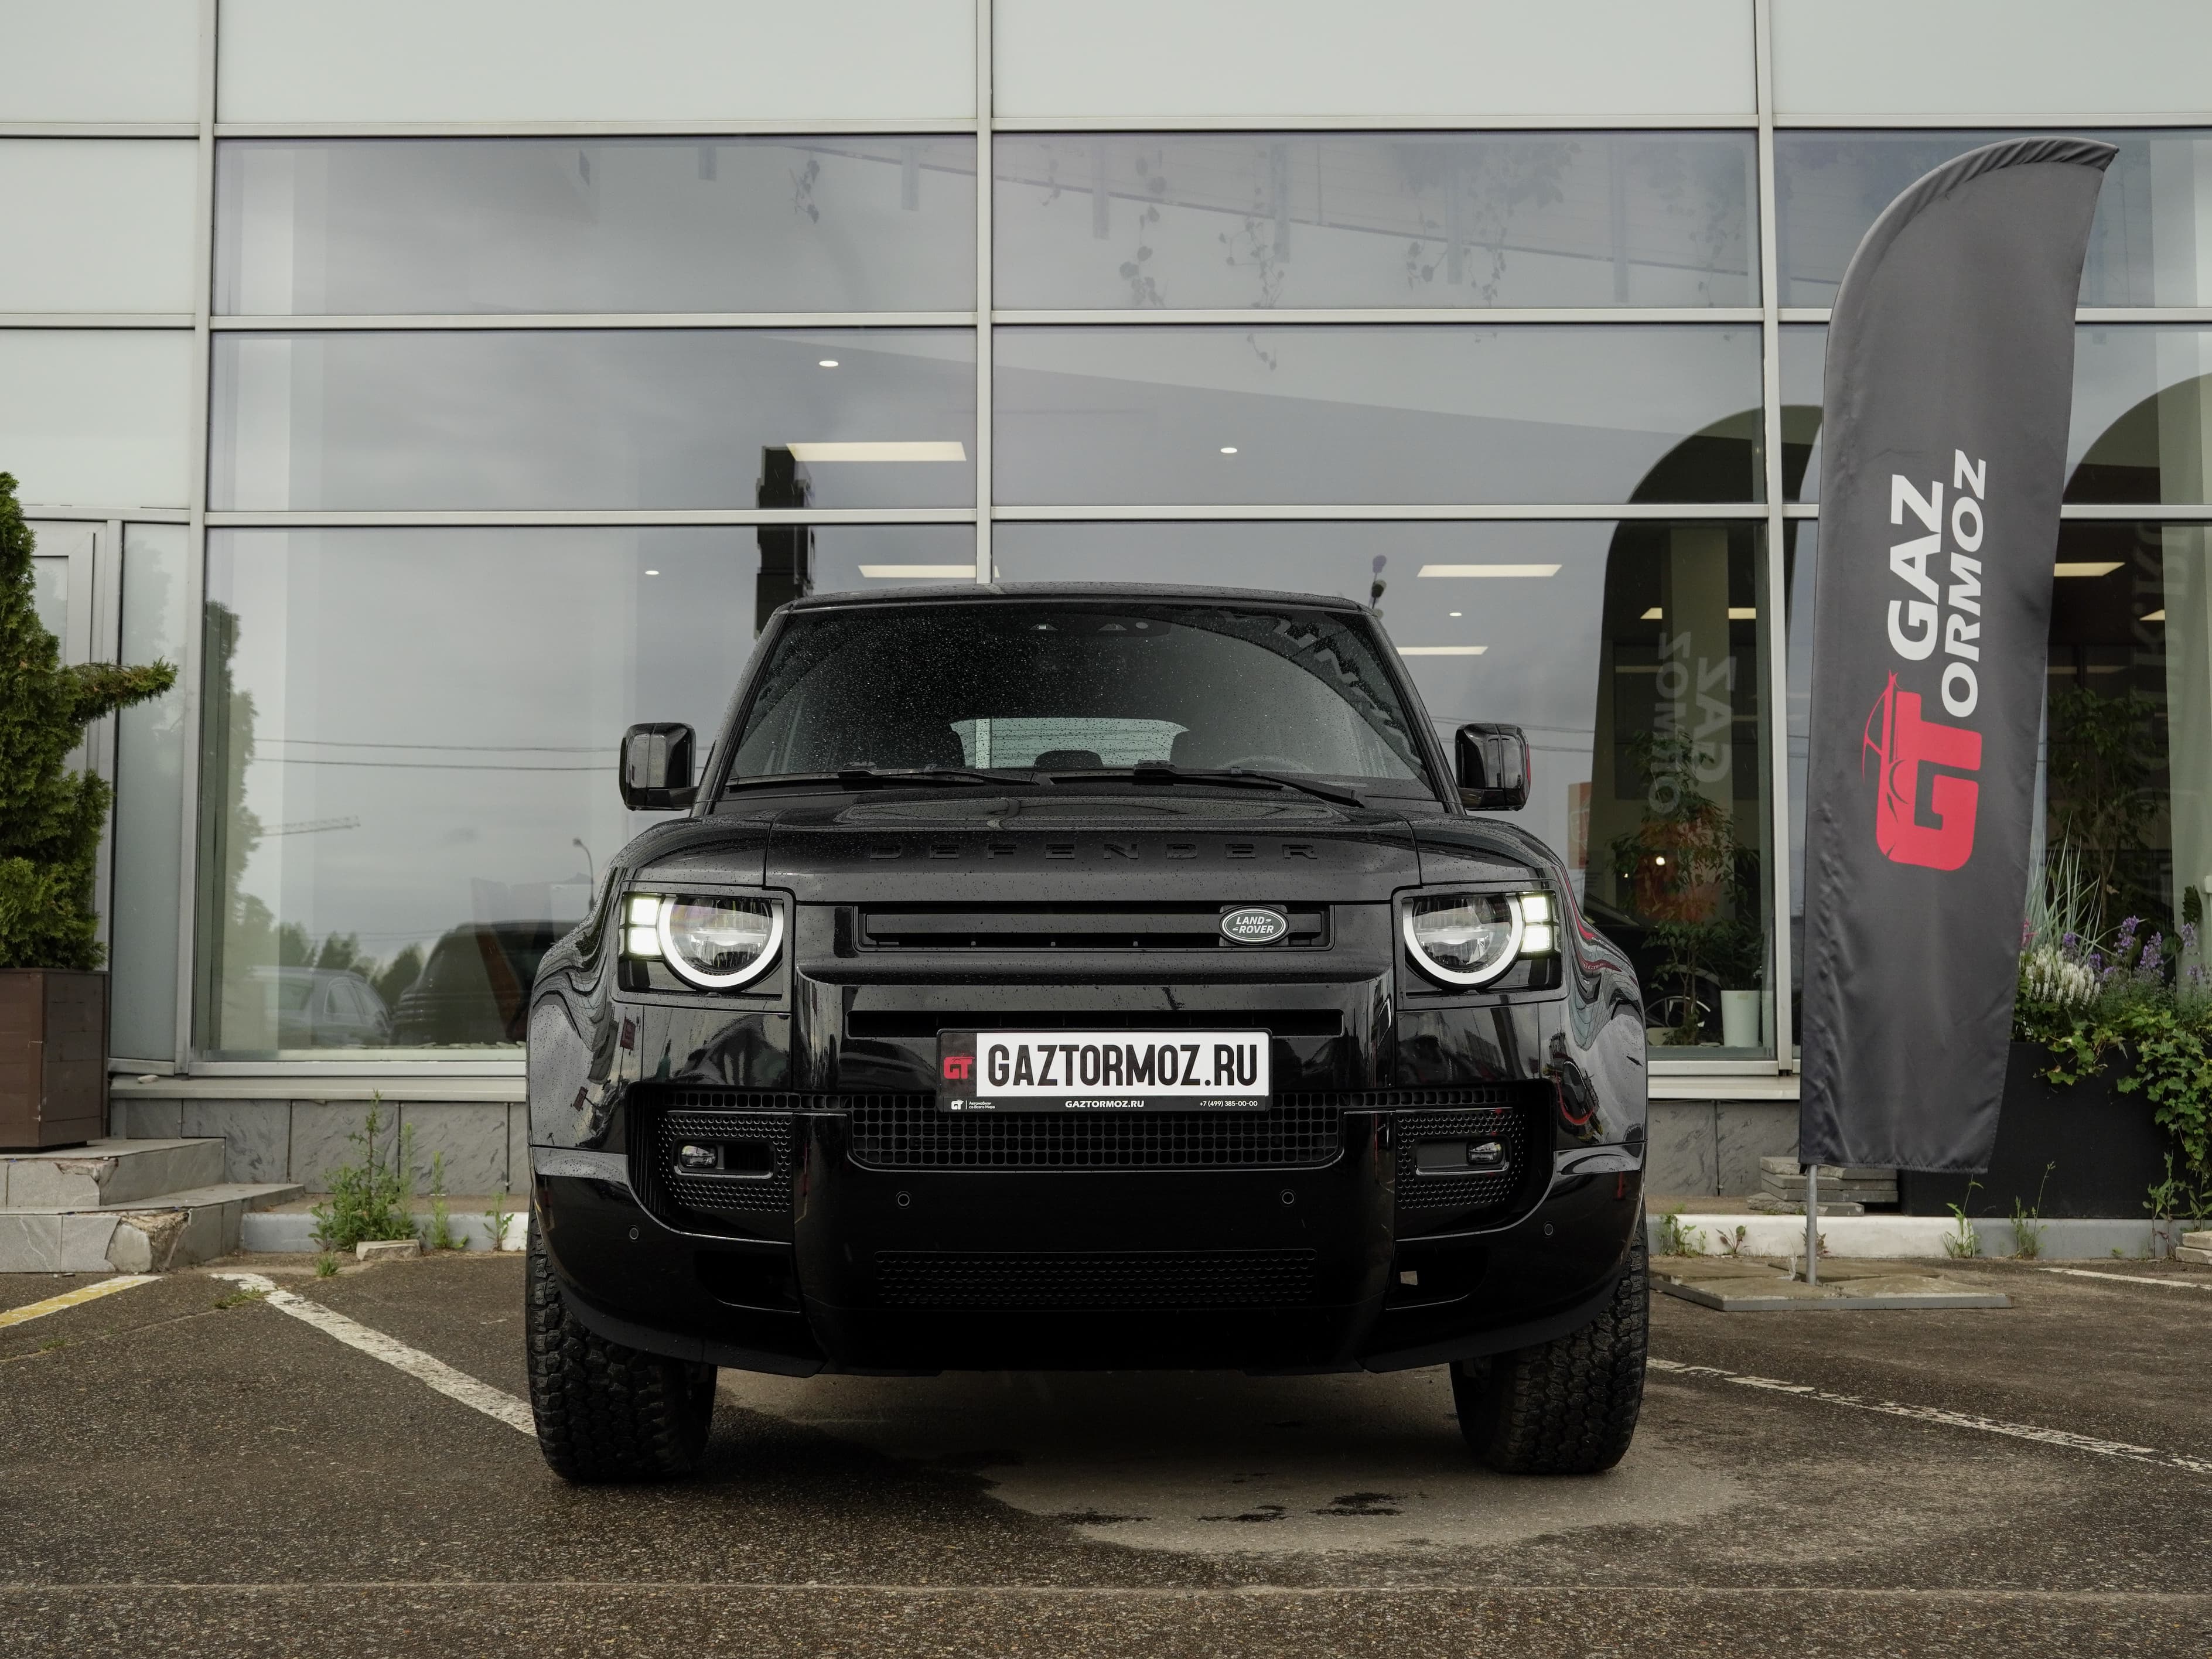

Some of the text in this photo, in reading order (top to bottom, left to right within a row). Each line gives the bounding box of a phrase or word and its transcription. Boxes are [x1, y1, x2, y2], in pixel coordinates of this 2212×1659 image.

[1887, 474, 1944, 661] GAZ
[1941, 449, 1986, 718] ORMOZ
[1876, 691, 1982, 871] GT
[870, 844, 1317, 859] DEFENDER
[1236, 916, 1265, 924] LAND
[1238, 925, 1274, 933] ROVER
[944, 1044, 1257, 1087] GT GAZTORMOZ.RU
